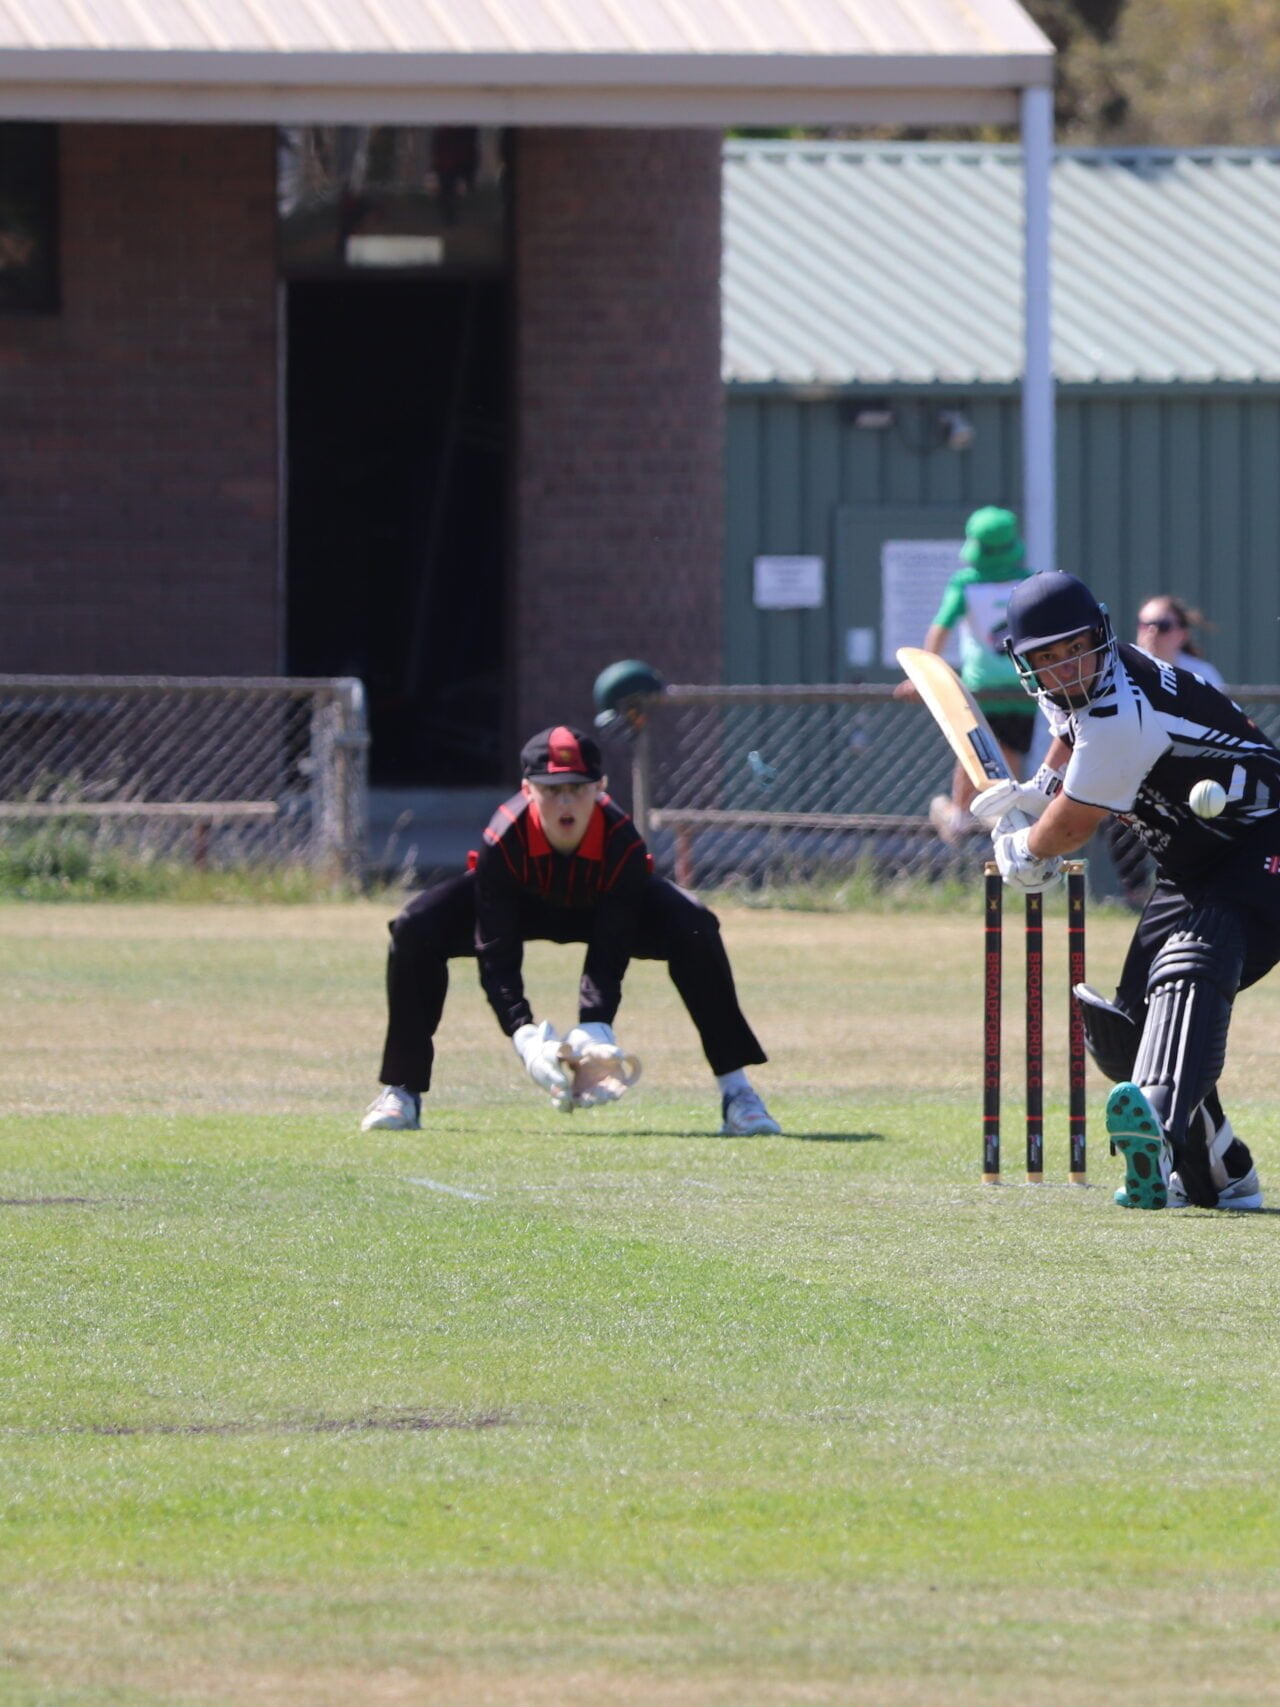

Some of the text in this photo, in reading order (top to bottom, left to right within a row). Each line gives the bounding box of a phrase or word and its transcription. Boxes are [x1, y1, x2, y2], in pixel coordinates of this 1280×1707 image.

[986, 952, 1000, 1056] BROADFORD
[1029, 952, 1042, 1056] BROADFORD
[1071, 952, 1084, 1056] BRODFORD
